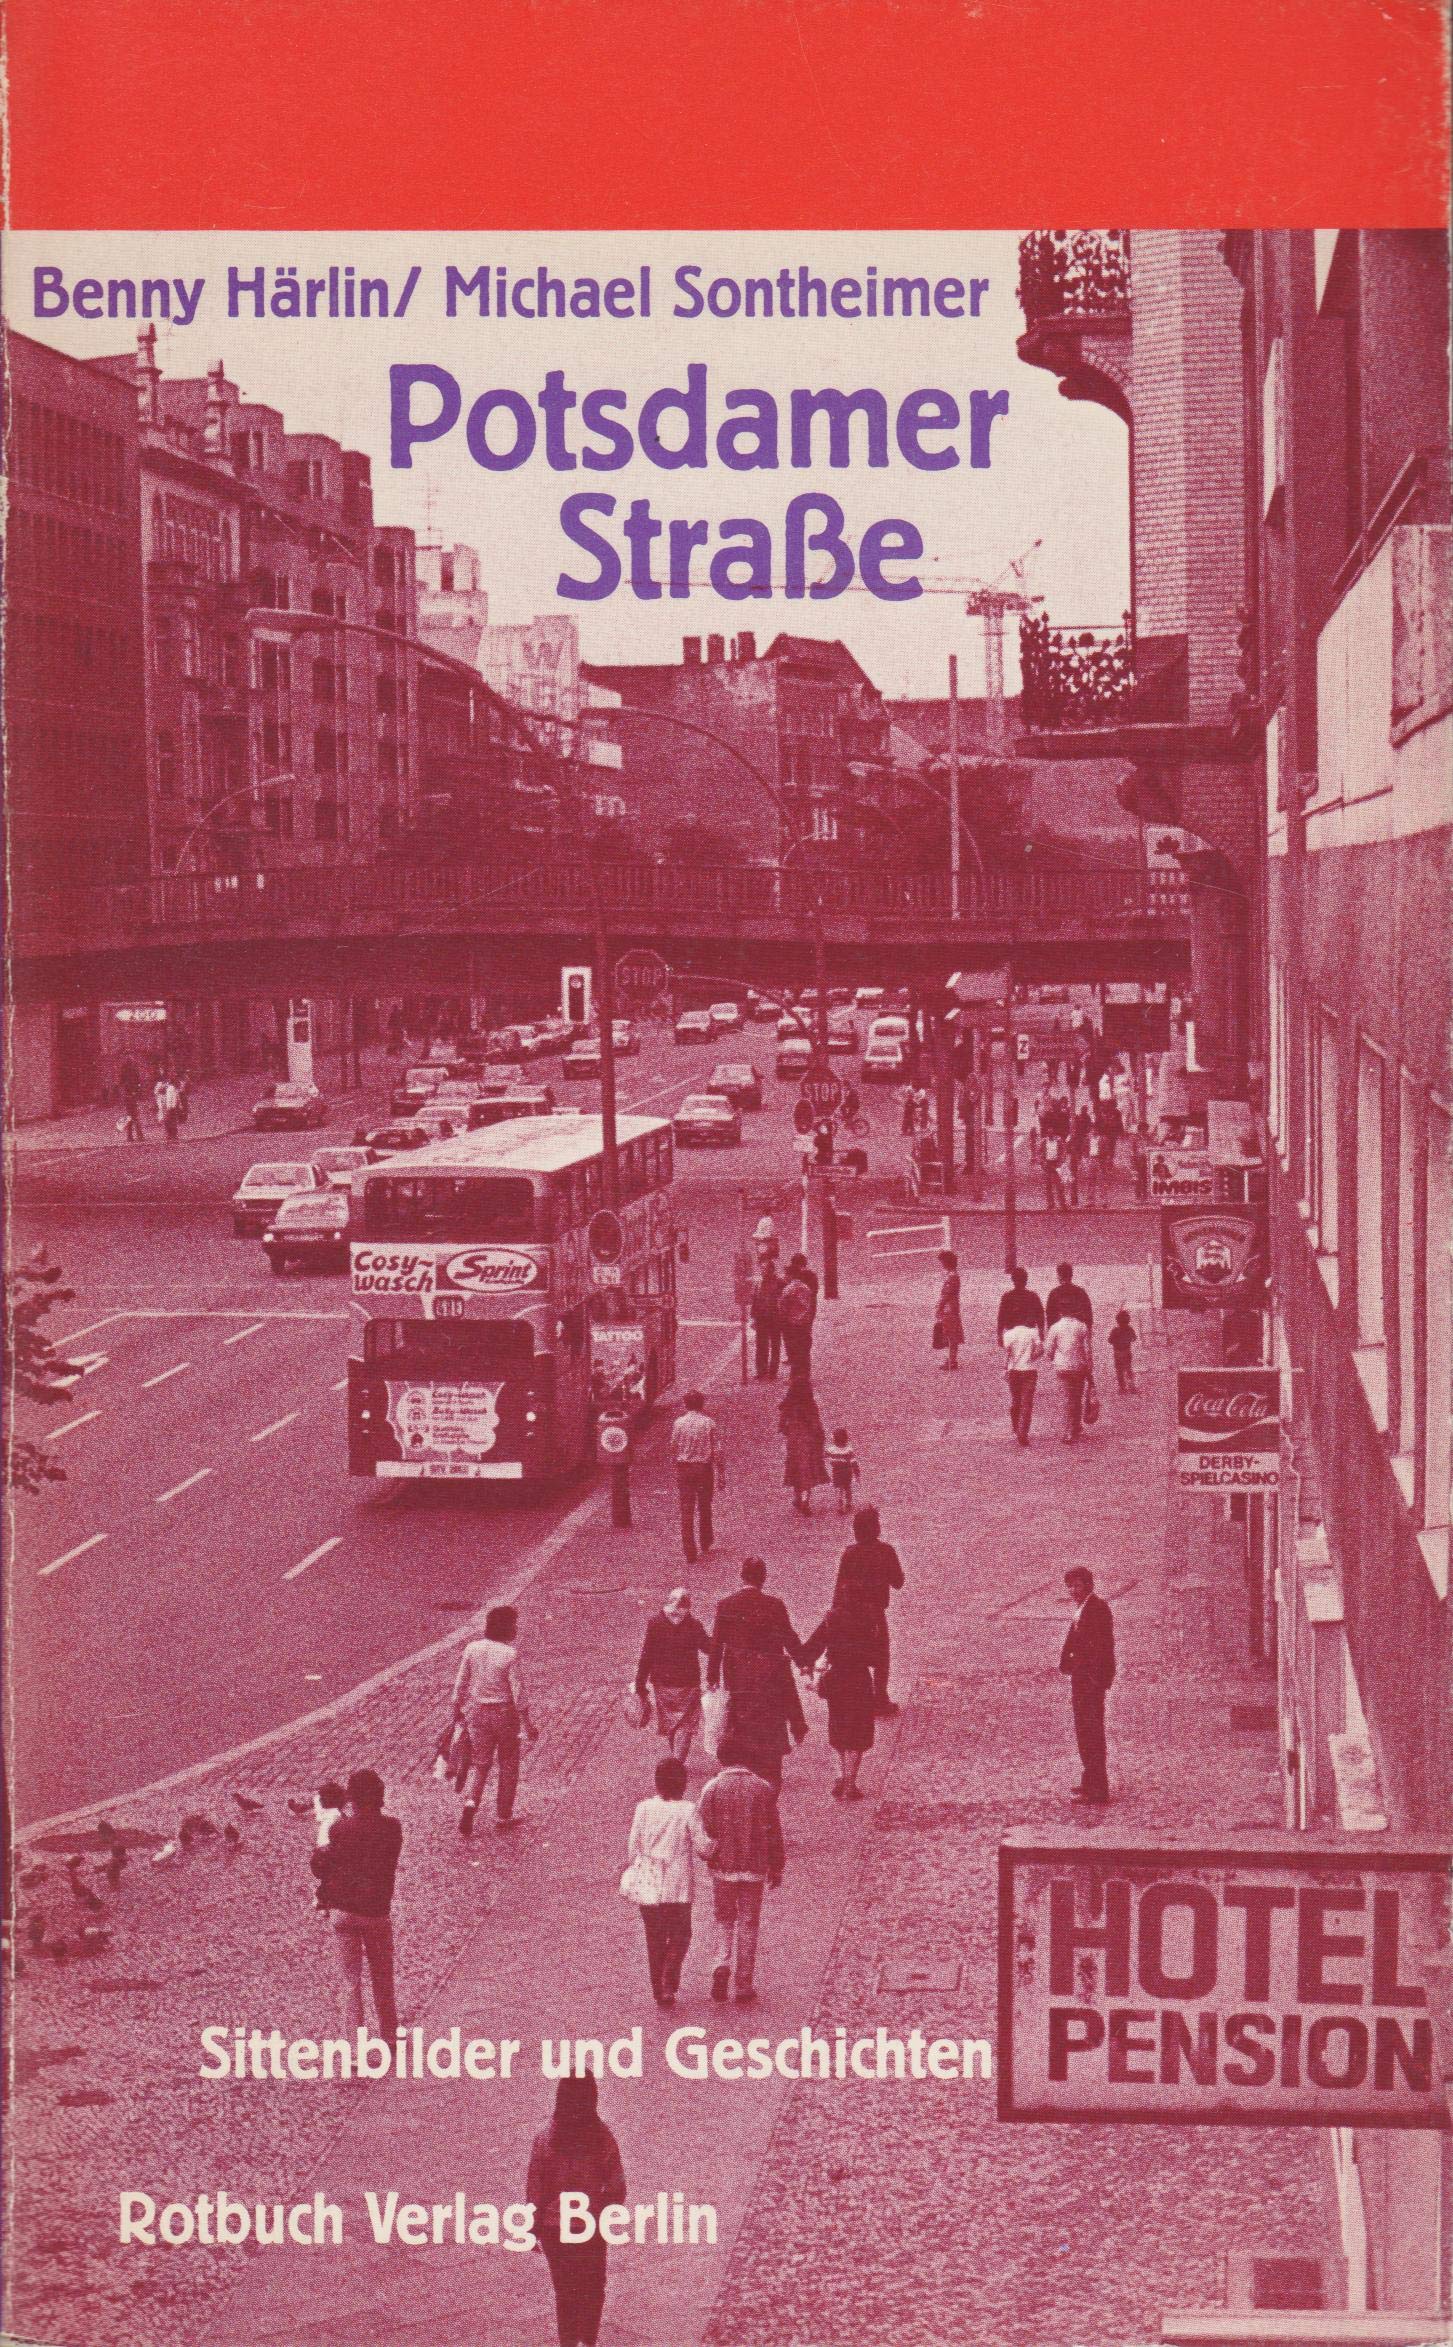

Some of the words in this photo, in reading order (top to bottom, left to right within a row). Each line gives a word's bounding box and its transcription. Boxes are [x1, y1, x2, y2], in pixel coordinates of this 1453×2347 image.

[34, 266, 205, 326] Benny
[228, 266, 421, 319] Härlin/
[447, 266, 650, 319] Michael
[674, 266, 989, 319] Sontheimer
[390, 364, 1009, 472] Potsdamer
[556, 492, 923, 602] Straße
[803, 1082, 840, 1102] STOP
[354, 1270, 434, 1292] wasch
[453, 1255, 532, 1283] Sprint
[1180, 1471, 1280, 1485] SPIELCASINO
[1200, 1455, 1260, 1470] DERBY-
[1048, 1879, 1427, 2007] HOTEL
[200, 2026, 521, 2080] Sittenbilder
[541, 2026, 643, 2080] und
[664, 2026, 995, 2081] Geschichten
[1048, 2007, 1433, 2092] PENSION
[119, 2191, 343, 2245] Rotbuch
[365, 2191, 537, 2253] Verlag
[559, 2191, 719, 2246] Berlin
